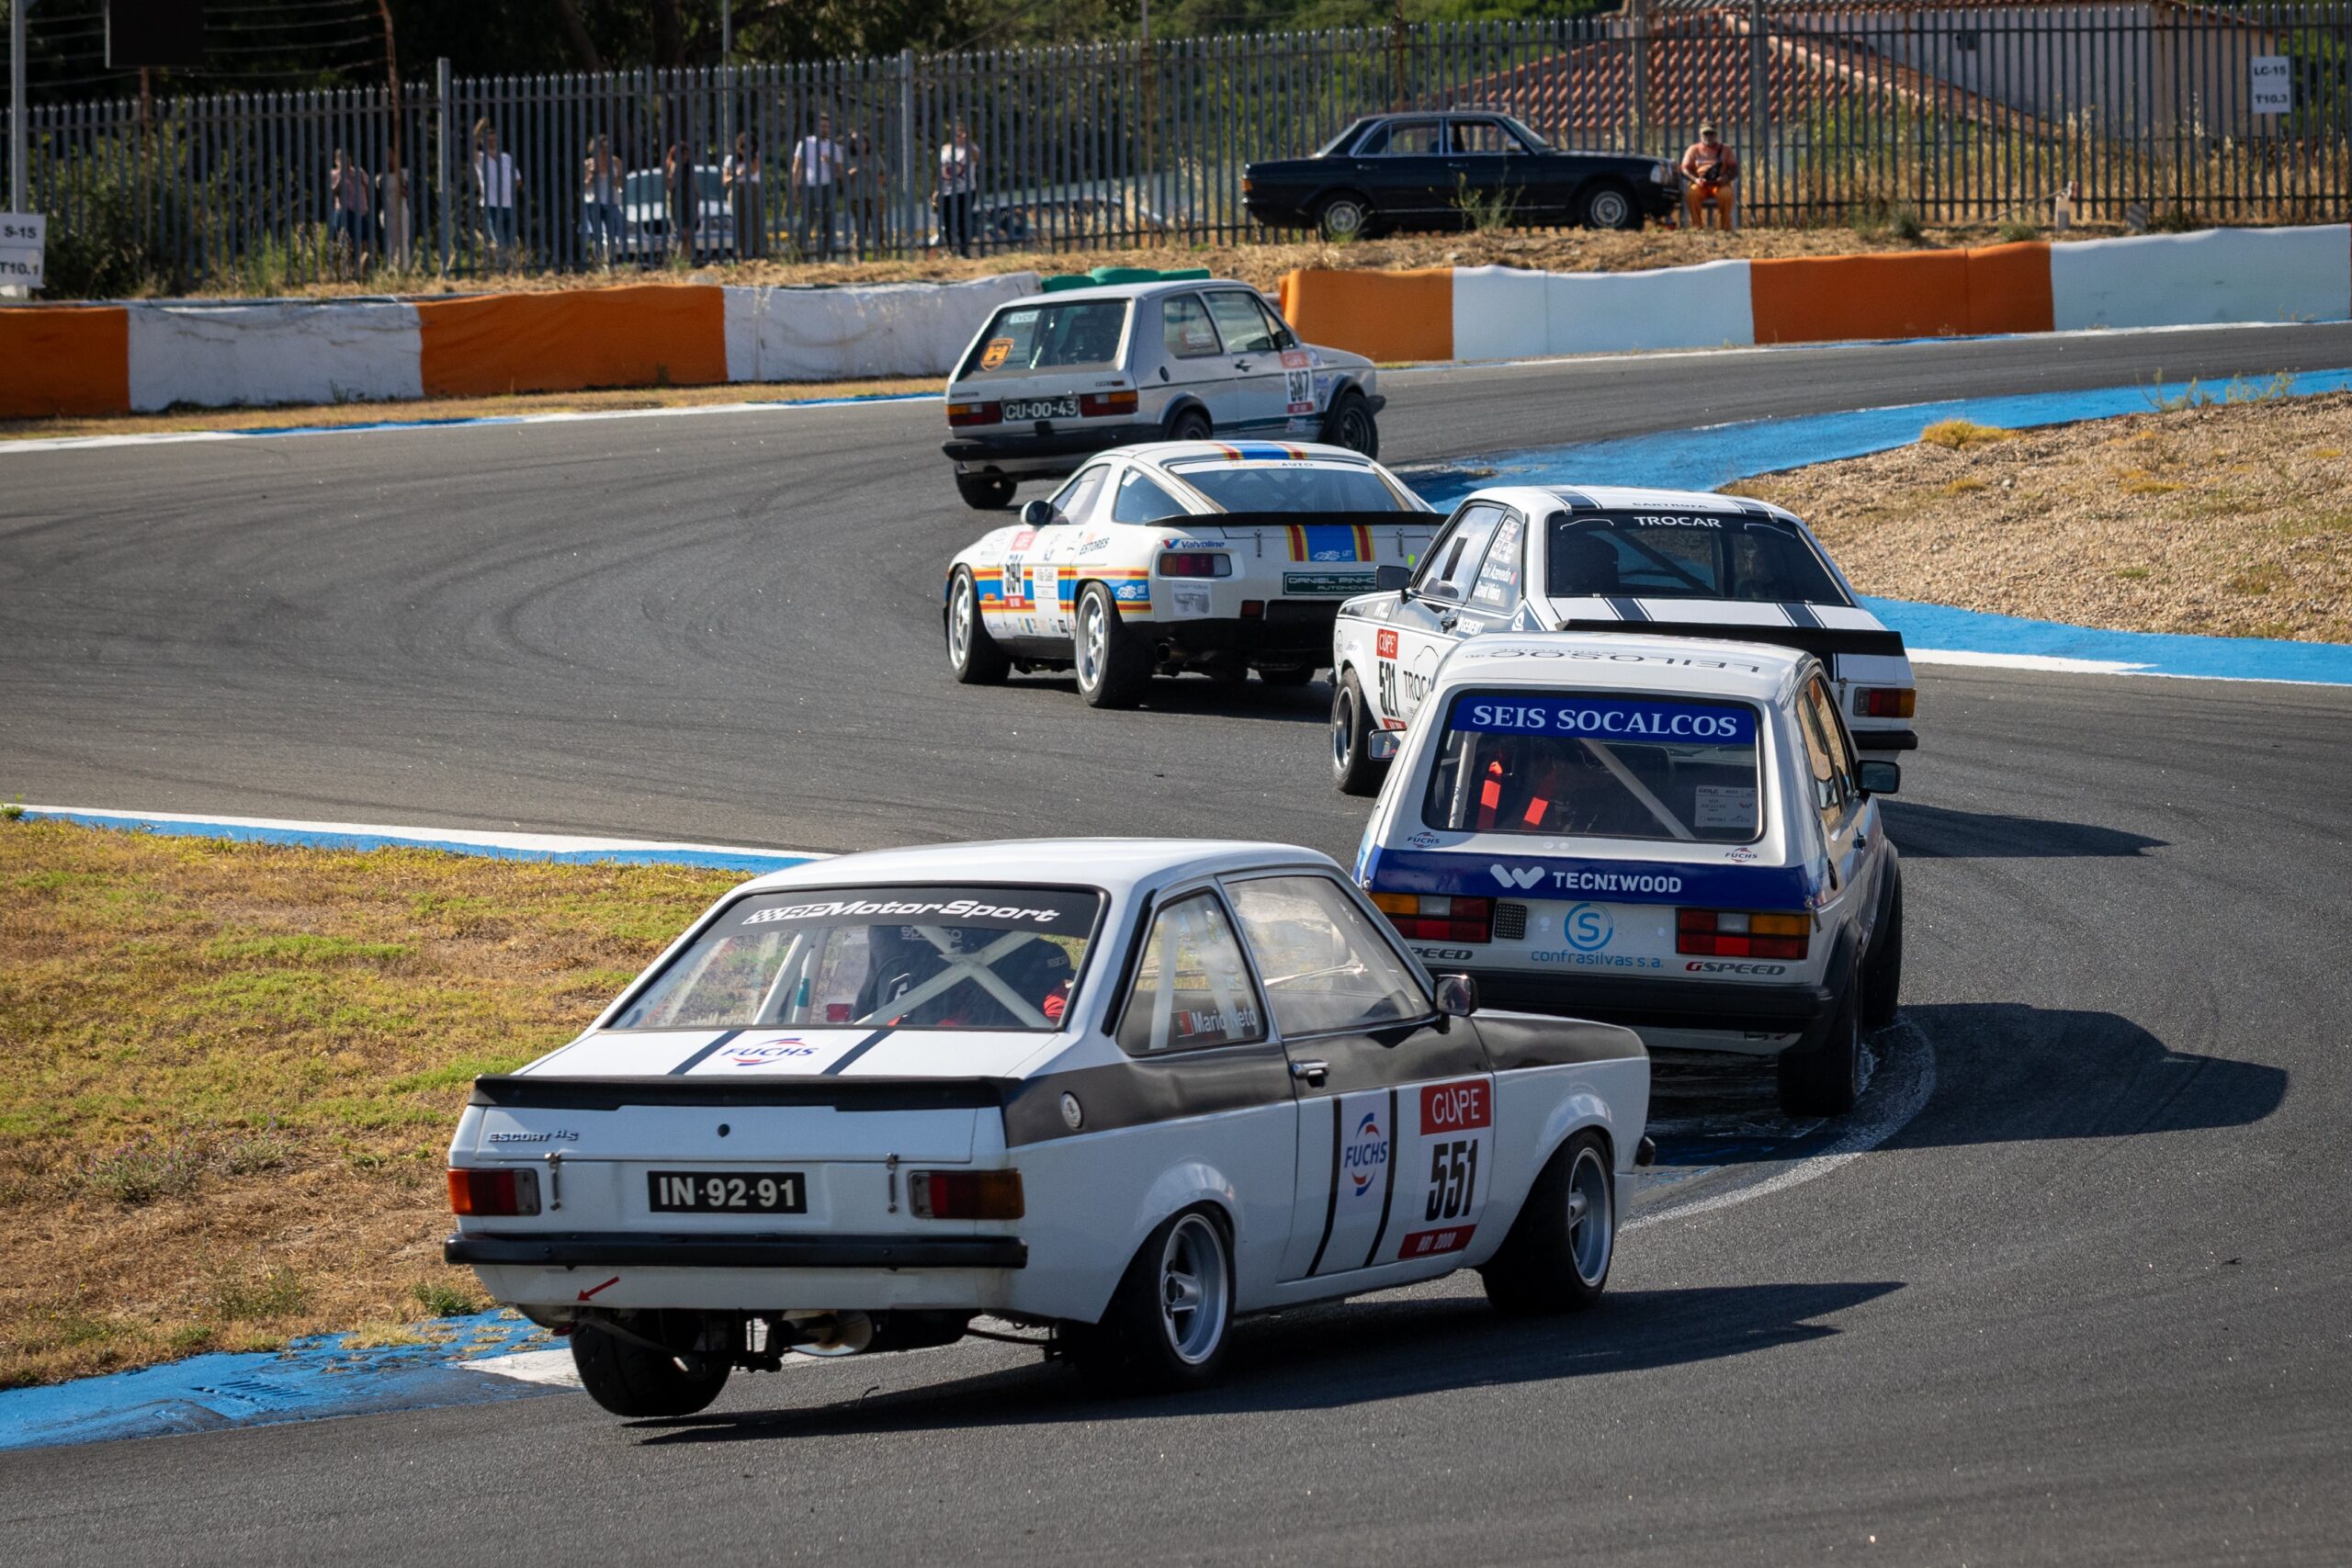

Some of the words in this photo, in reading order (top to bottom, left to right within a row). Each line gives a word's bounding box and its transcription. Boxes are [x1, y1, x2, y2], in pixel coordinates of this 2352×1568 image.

[2254, 65, 2287, 76] LC-15
[2256, 94, 2287, 104] T10.3
[4, 225, 37, 239] S-15
[0, 262, 39, 275] T10.1
[1005, 400, 1077, 418] CU-00-43
[1634, 516, 1723, 528] TROCAR
[1182, 539, 1226, 548] Valvoline
[1379, 660, 1400, 717] 521
[1472, 705, 1545, 728] SEIS
[1556, 709, 1737, 737] SOCALCOS
[1407, 836, 1440, 844] FUCHS
[1553, 872, 1682, 893] TECNIWOOD
[1531, 950, 1633, 967] confrasilvas
[1637, 956, 1664, 967] s.a.
[1685, 961, 1786, 976] GSPEED
[720, 1047, 820, 1057] FUCHS
[487, 1132, 550, 1143] ESCORT
[554, 1129, 580, 1142] RS
[1344, 1141, 1388, 1168] FUCHS
[1425, 1139, 1478, 1222] 551
